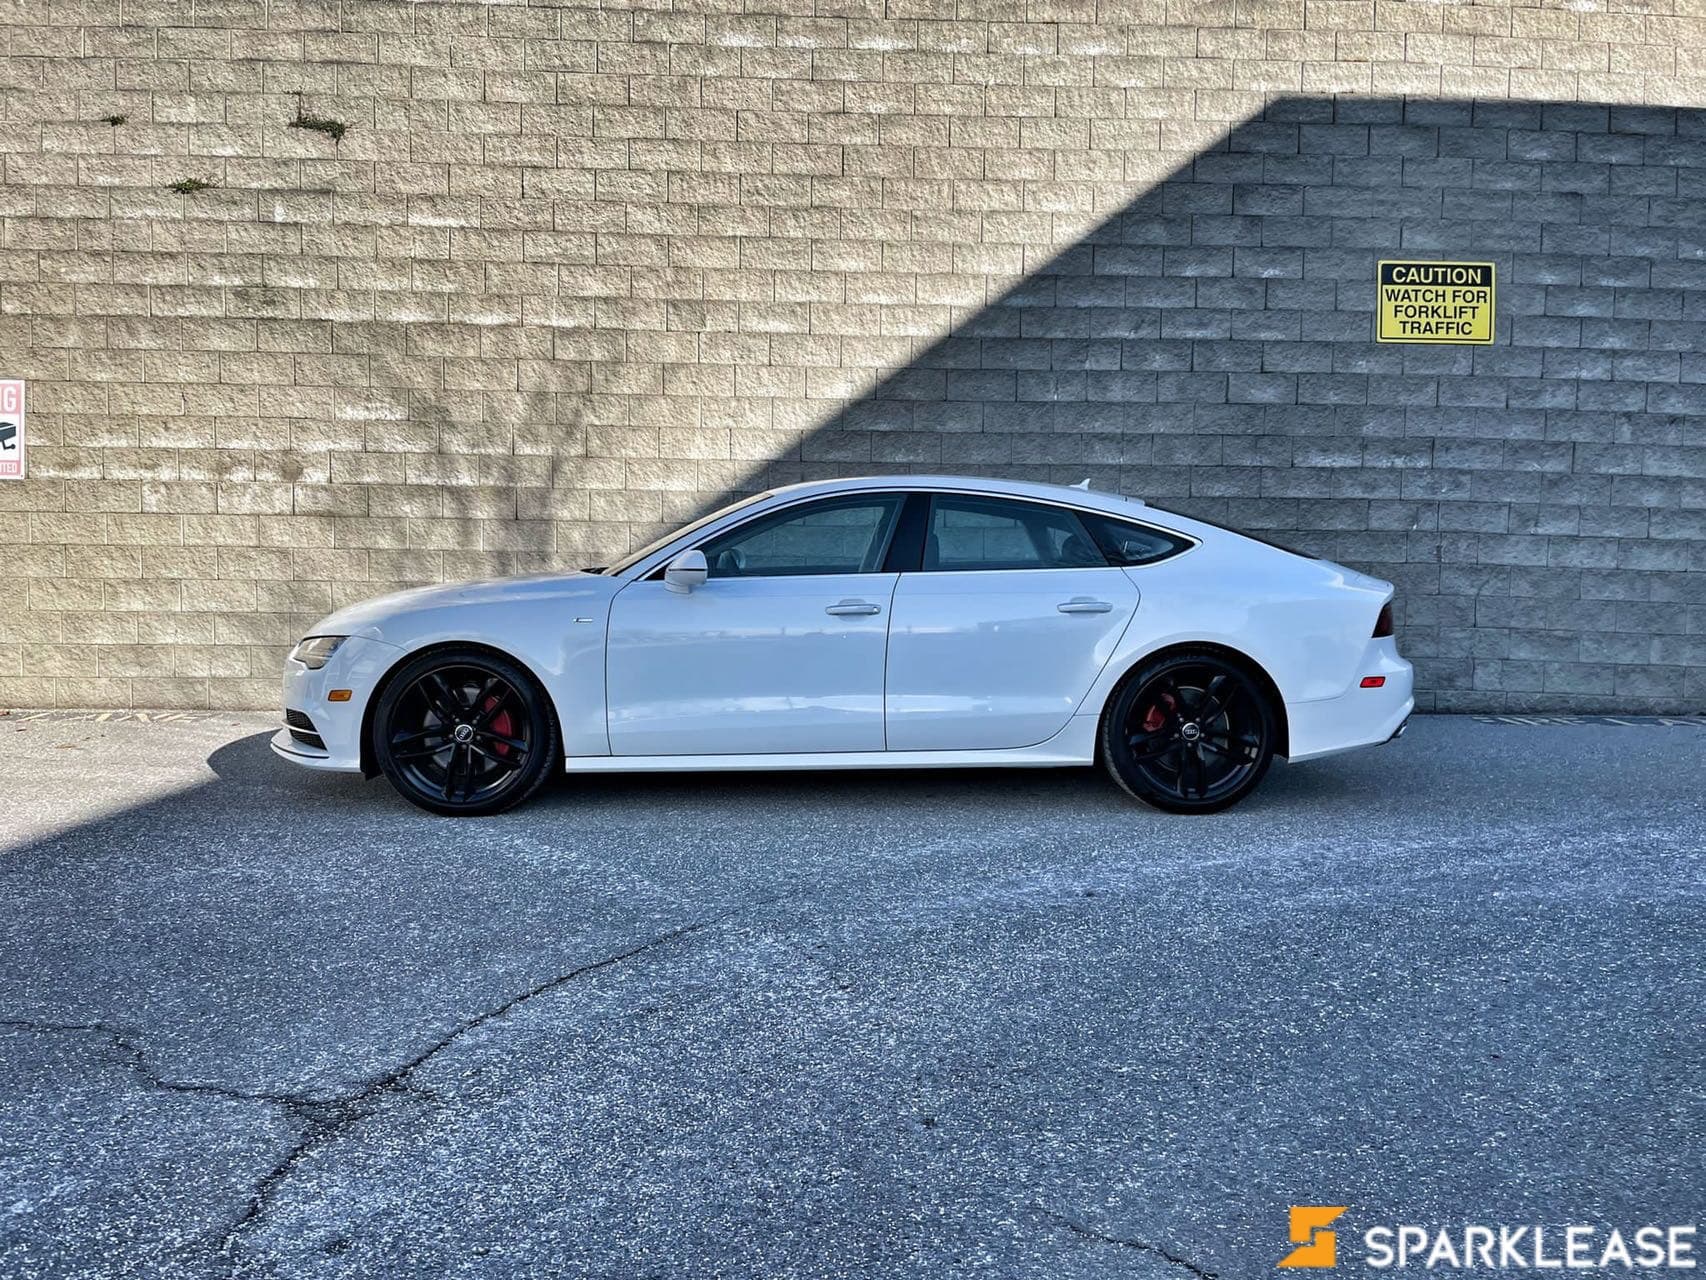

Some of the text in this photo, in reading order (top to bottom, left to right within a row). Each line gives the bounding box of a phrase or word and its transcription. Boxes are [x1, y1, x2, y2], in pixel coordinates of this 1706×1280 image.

[1392, 267, 1481, 284] CAUTION
[1385, 289, 1488, 303] WATCH FOR
[1394, 305, 1479, 319] FORKLIFT
[1399, 321, 1472, 335] TRAFFIC
[0, 386, 17, 412] G
